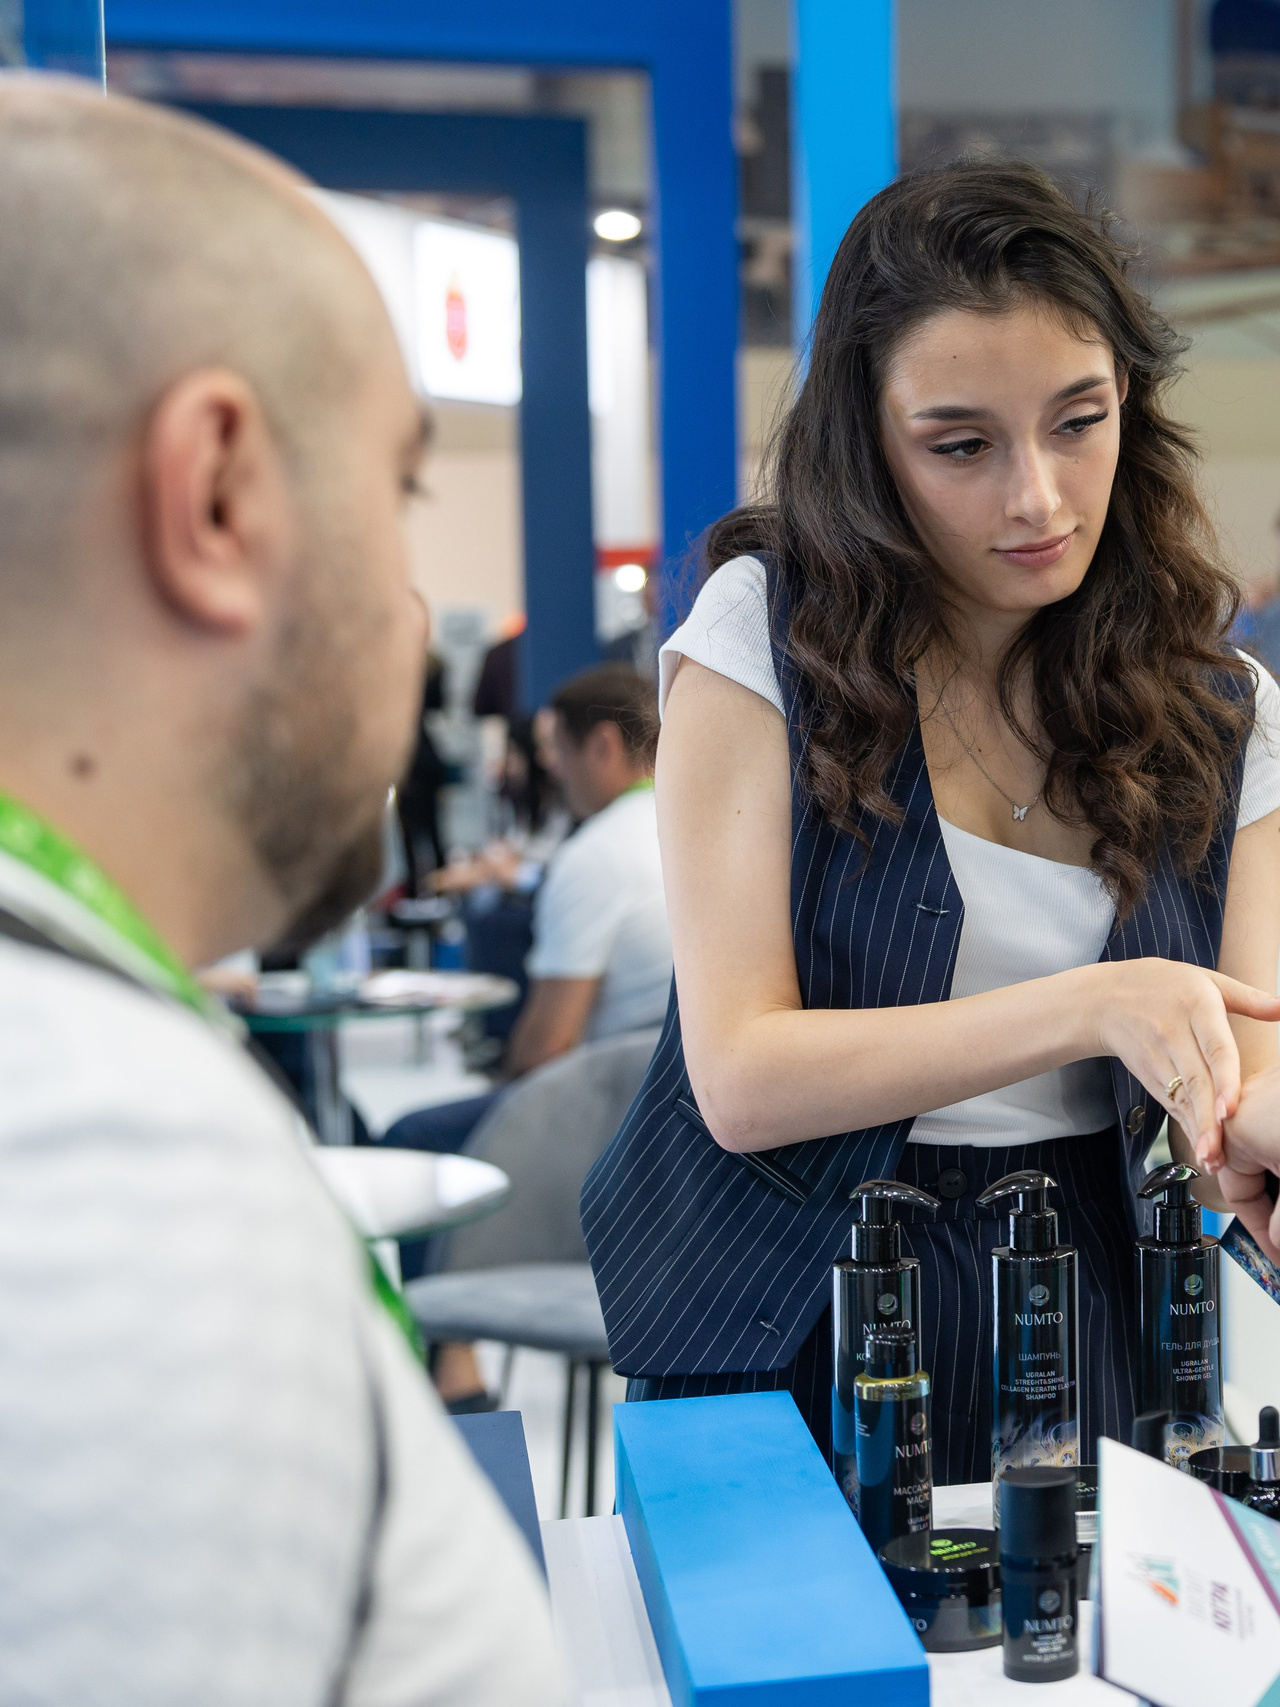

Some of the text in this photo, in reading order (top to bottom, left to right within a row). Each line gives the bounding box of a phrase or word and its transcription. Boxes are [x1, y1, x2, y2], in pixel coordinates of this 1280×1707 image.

[1169, 1300, 1215, 1316] NUMTO
[1015, 1311, 1064, 1326] NUMTO
[1161, 1342, 1183, 1351] ГЕЛЬ
[1184, 1341, 1202, 1351] ДЛЯ
[1018, 1351, 1061, 1361] ШАМПУНЬ
[1181, 1358, 1209, 1367] UGRALAN
[1025, 1370, 1056, 1378] UGRALAN
[1172, 1363, 1215, 1375] ULTRA-GENTLE
[1176, 1374, 1202, 1382] SHOWER
[1001, 1384, 1030, 1393] COLLAGEN
[1030, 1385, 1057, 1393] KERATIN
[1025, 1392, 1057, 1401] SHAMPOO
[1023, 1615, 1073, 1633] NUMTO
